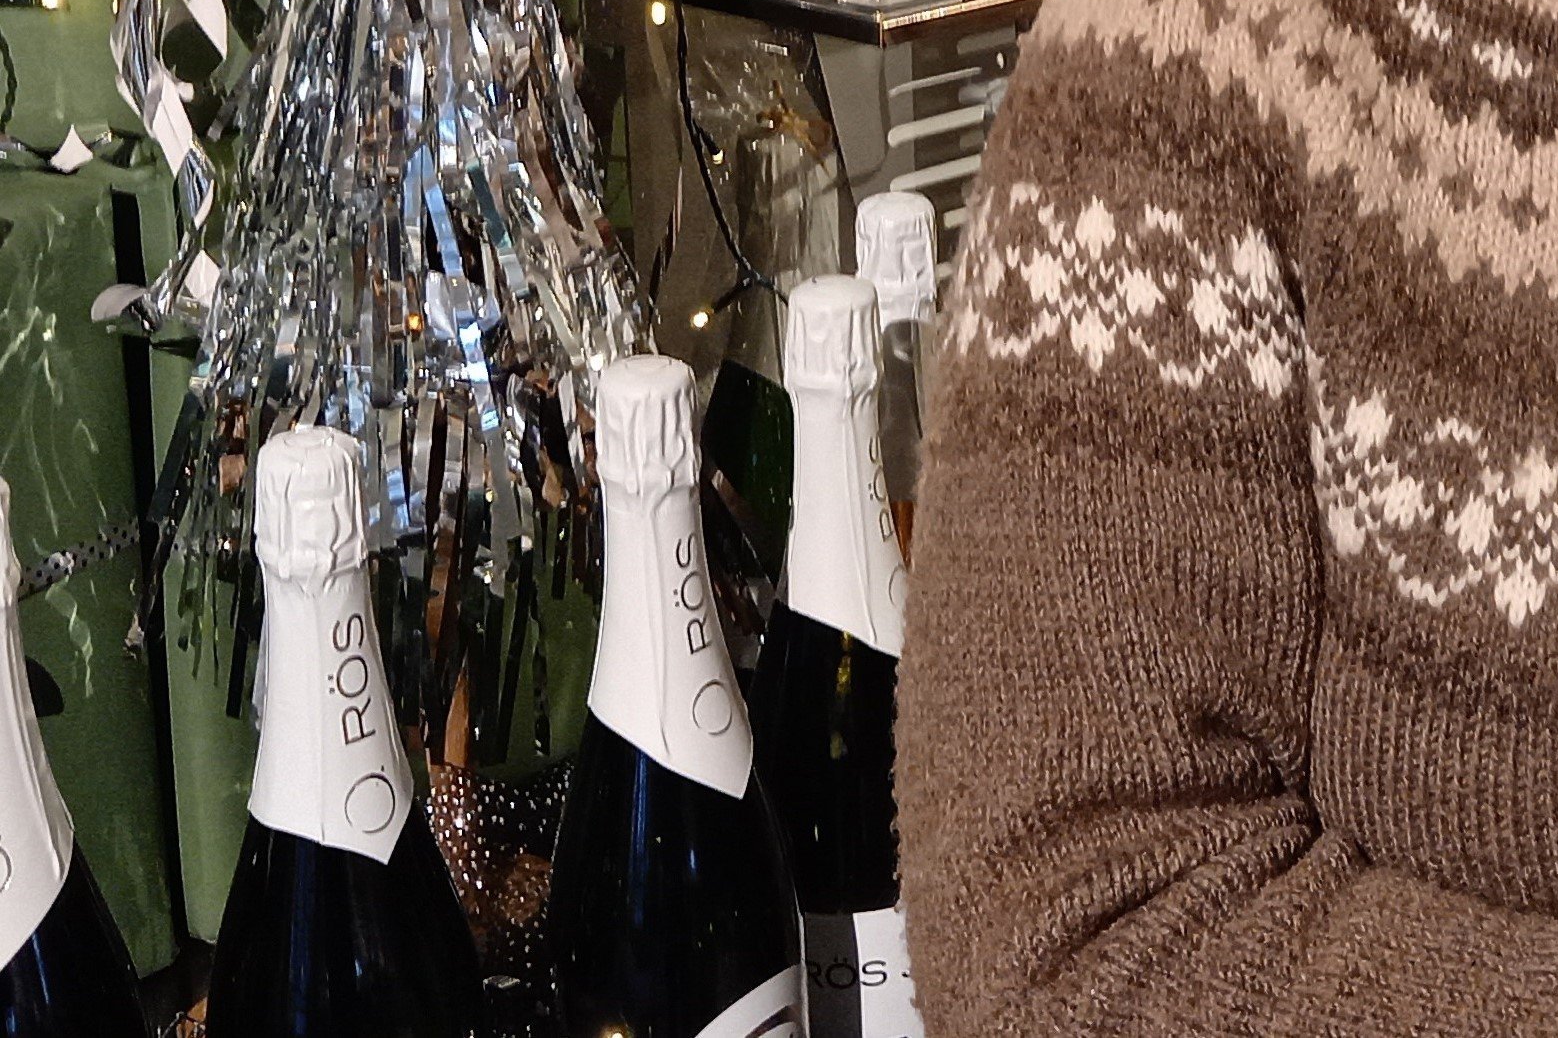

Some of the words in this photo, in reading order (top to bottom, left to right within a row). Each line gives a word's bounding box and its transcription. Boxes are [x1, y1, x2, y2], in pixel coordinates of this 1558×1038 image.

[673, 532, 713, 655] RÖS
[327, 613, 376, 747] RÖS
[806, 957, 887, 989] RÖS
